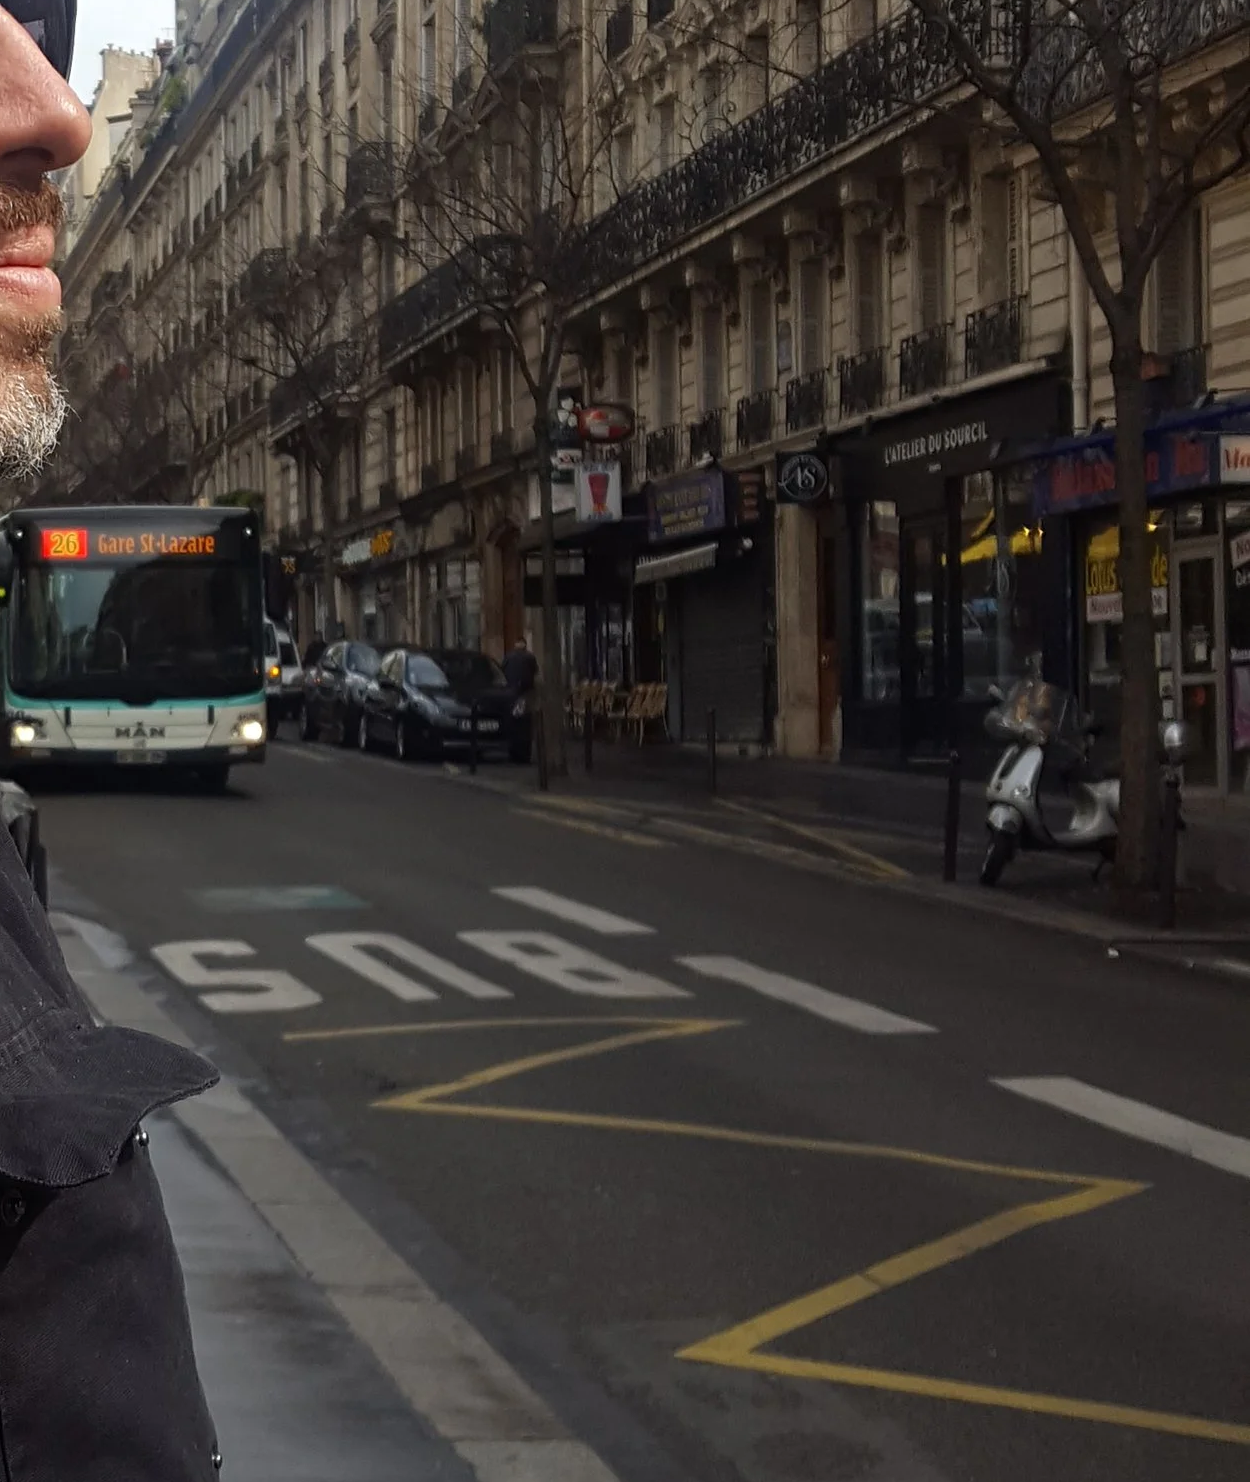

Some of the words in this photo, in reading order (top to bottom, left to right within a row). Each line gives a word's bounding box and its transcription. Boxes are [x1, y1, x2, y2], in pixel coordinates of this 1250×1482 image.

[884, 435, 926, 467] L'ATELIER
[928, 431, 942, 455] DU
[944, 421, 989, 451] SOURCIL
[51, 533, 80, 555] 26
[98, 533, 135, 554] Gare
[115, 722, 166, 739] MAN
[150, 928, 695, 1013] BUS
